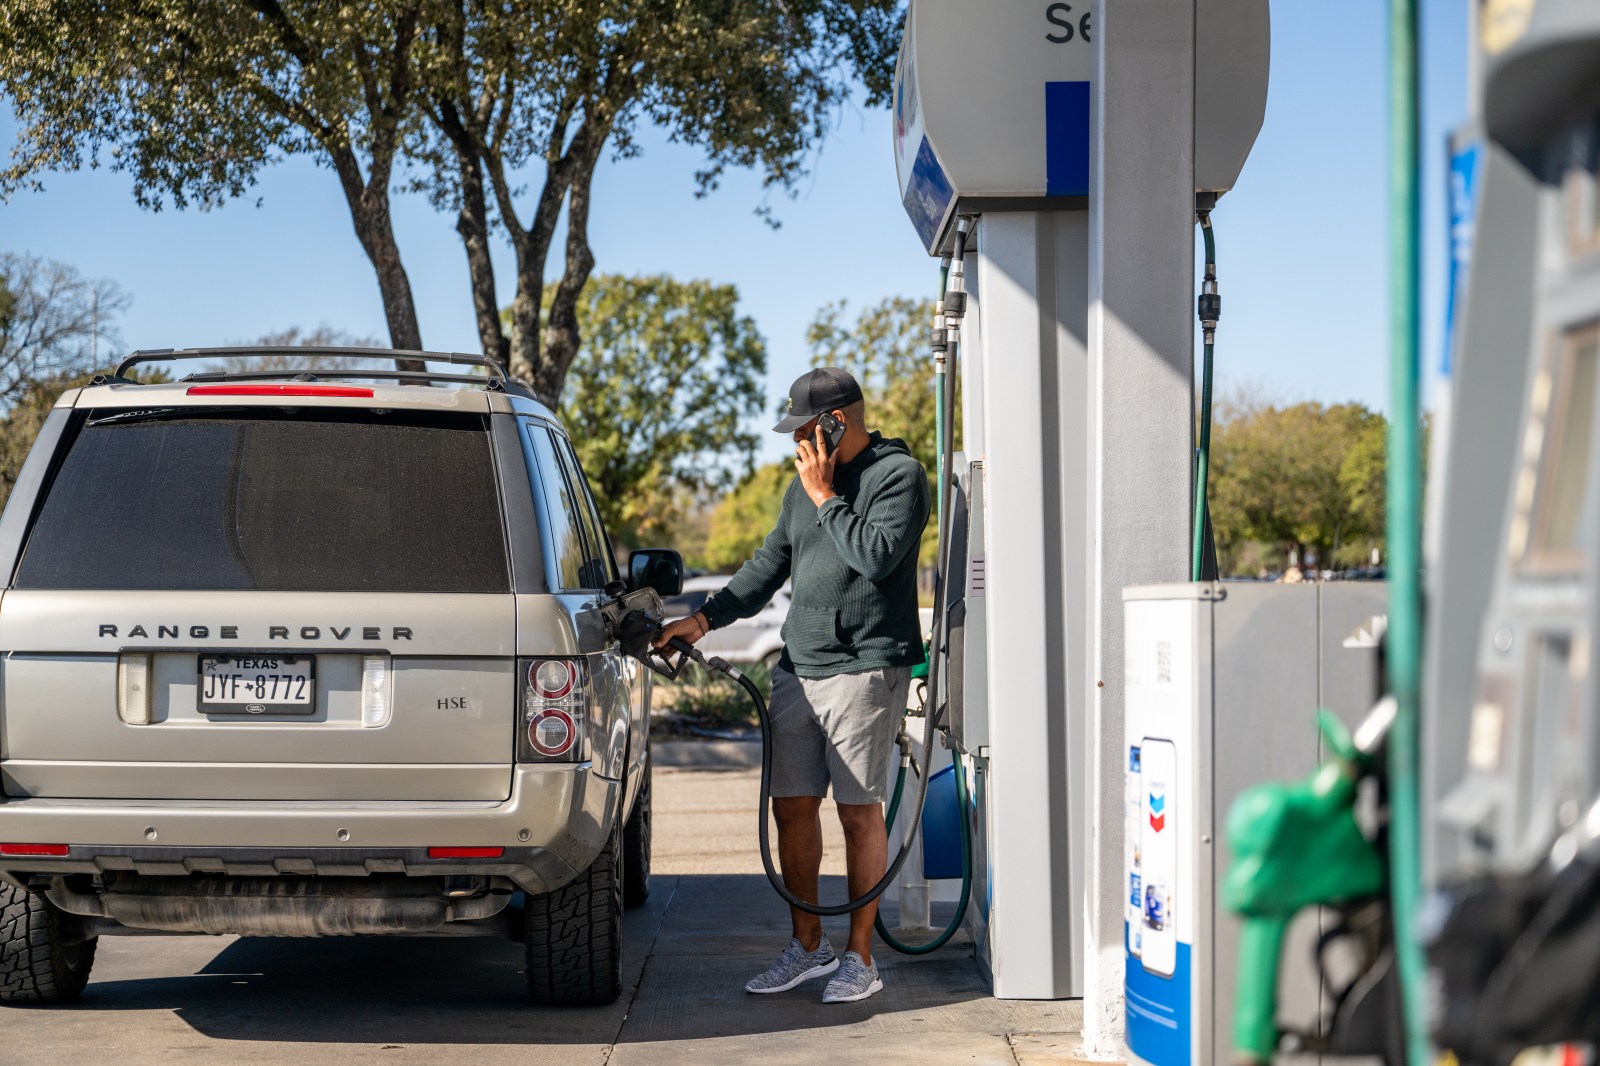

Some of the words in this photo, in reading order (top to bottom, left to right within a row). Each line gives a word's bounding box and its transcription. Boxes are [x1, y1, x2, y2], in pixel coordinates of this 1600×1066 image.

[98, 624, 239, 639] RANGE
[269, 625, 414, 640] ROVER
[234, 659, 279, 670] TEXAS
[204, 674, 242, 699] JYF
[255, 675, 305, 700] 8772
[437, 696, 467, 710] HSE
